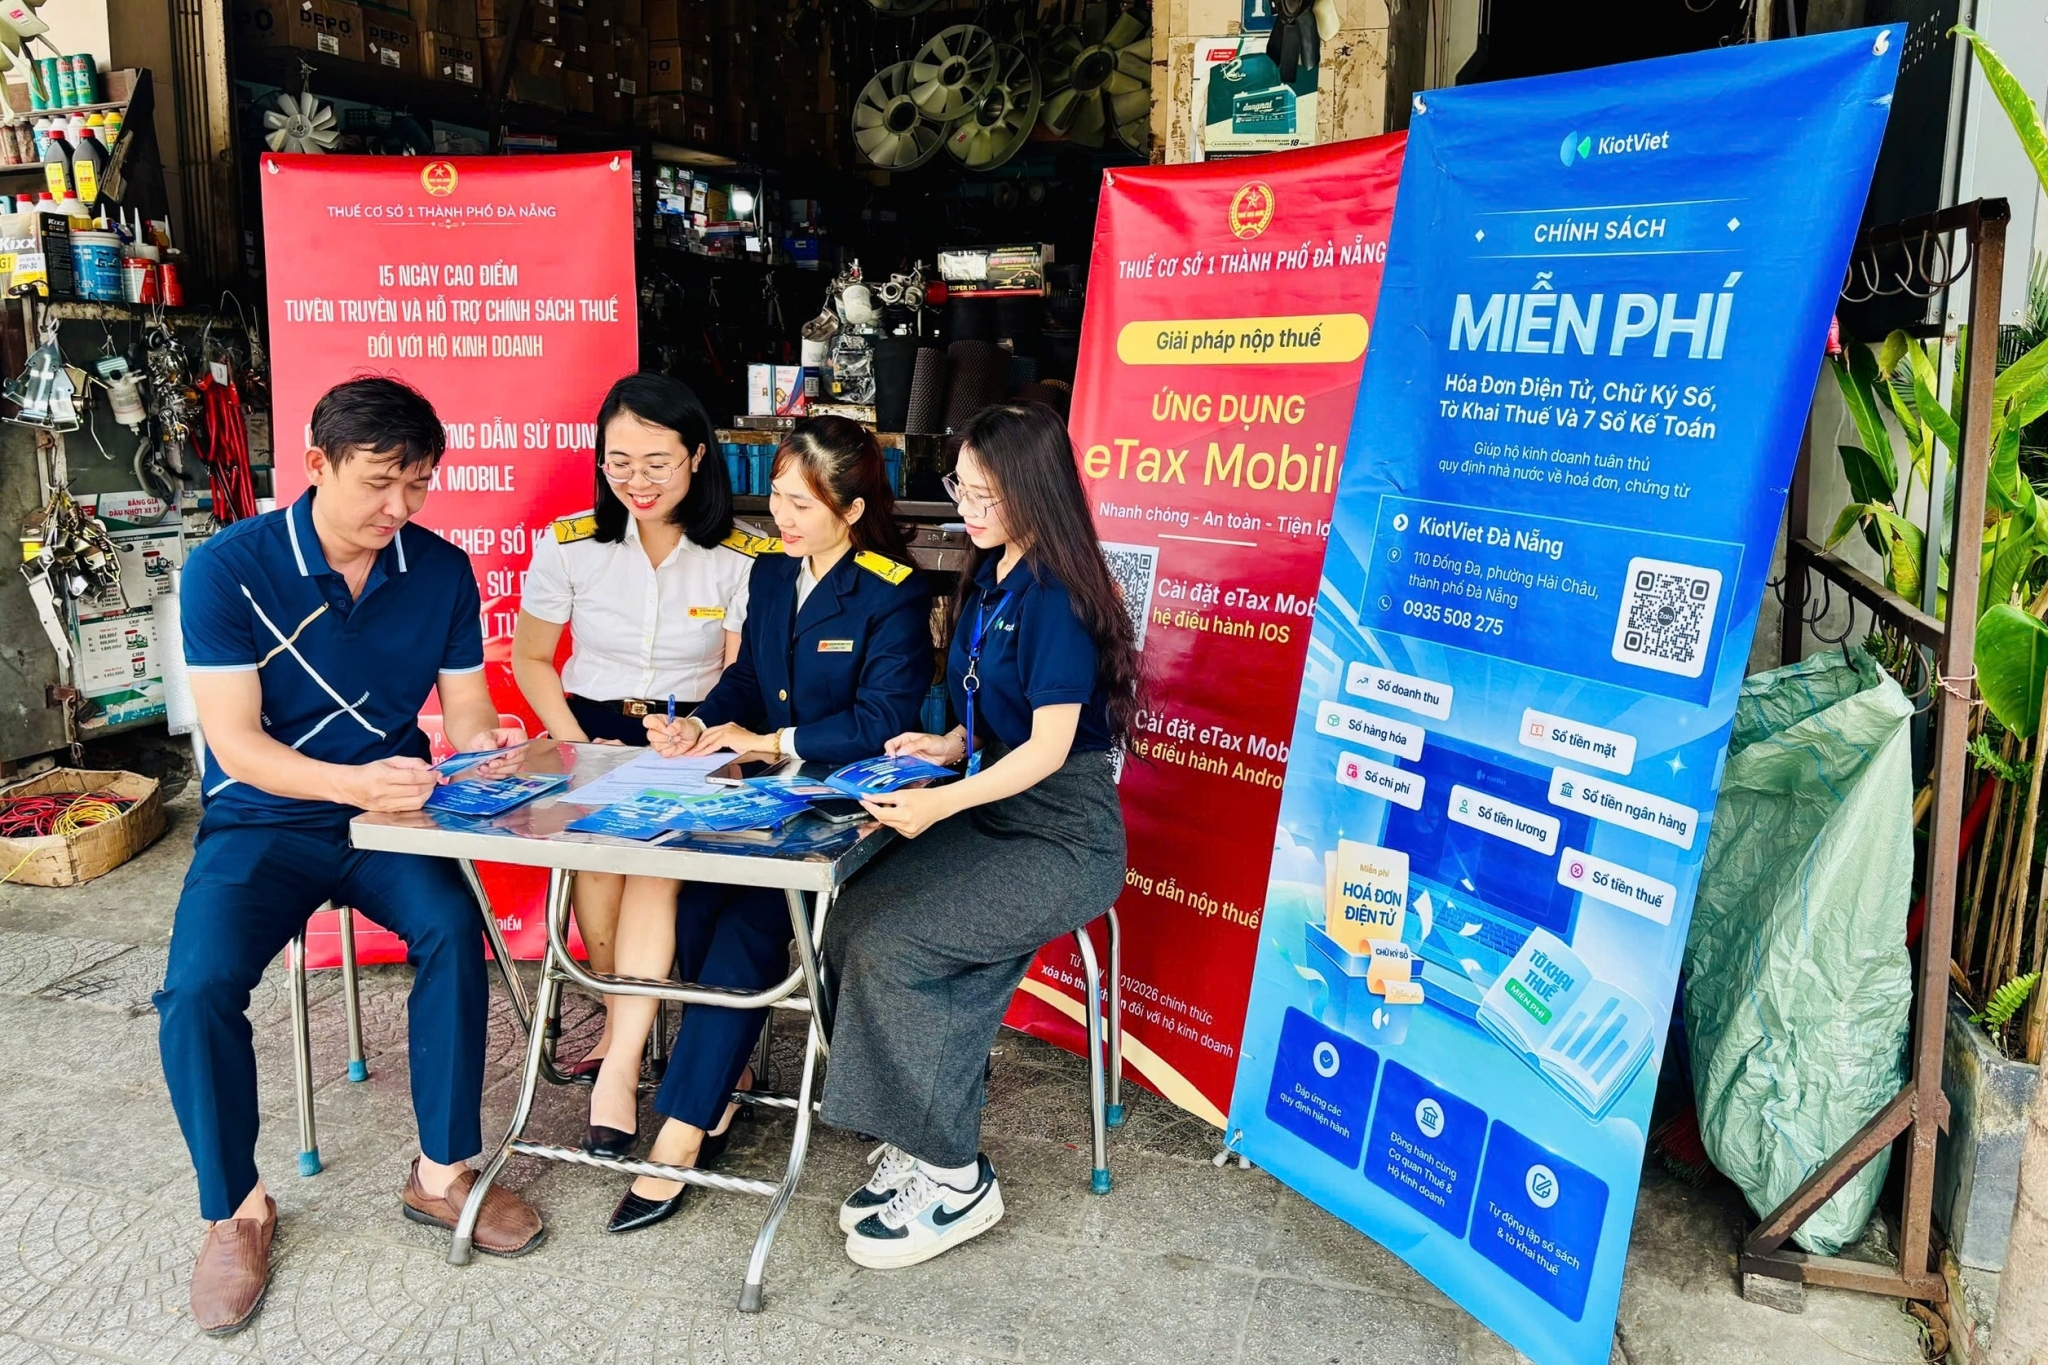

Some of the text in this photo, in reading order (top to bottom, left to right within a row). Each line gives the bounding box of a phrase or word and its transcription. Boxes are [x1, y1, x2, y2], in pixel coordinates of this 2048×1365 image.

[1598, 131, 1669, 155] KiotViet
[327, 202, 556, 218] THUẾ CƠ SỞ 1 THÀNH PHỐ ĐÀ NẴNG
[0, 238, 36, 250] Kixx
[1534, 215, 1666, 243] CHÍNH SÁCH
[379, 259, 518, 286] 15 NGÀY CAO ĐIỂM
[1118, 234, 1386, 279] THUẾ CƠ SỞ 1 THÀNH PHỐ ĐÀ NẴNG
[285, 293, 618, 324] TUYÊN TRUYỀN VÀ HỖ TRỢ CHÍNH SÁCH THUẾ
[1449, 271, 1743, 359] MIỄN PHÍ
[368, 331, 543, 360] ĐỐI VỚI HỘ KINH DOANH
[1156, 323, 1323, 353] Giải pháp nộp thuế
[1152, 386, 1305, 431] ỨNG DỤNG
[1445, 374, 1718, 411] Hóa Đơn Điện Tử, Chữ Ký Số,
[481, 417, 518, 449] DẪN
[524, 419, 552, 449] SỬ
[1439, 401, 1716, 439] Tờ Khai Thuế Và 7 Sổ Kế Toán
[1084, 439, 1344, 494] eTax Mobil
[1474, 442, 1650, 472] Giúp hộ kinh doanh tuân thủ
[448, 465, 514, 491] MOBILE
[1099, 501, 1311, 538] Nhanh chóng An toàn Tiện
[450, 525, 495, 554] CHÉP
[501, 522, 525, 554] SỔ
[1419, 516, 1564, 560] KiotViet Đà Nẵng
[487, 566, 514, 596] SỬ
[1414, 551, 1599, 600] 110 Đống Đa, phường Hải Châu,
[1158, 578, 1268, 611] Cài đặt eTax
[1153, 608, 1289, 644] hệ điều hành IOS
[1403, 600, 1504, 636] 0935 508 275
[1658, 611, 1674, 621] Zalo
[1392, 685, 1421, 700] doanh
[1423, 691, 1439, 705] thu
[1569, 734, 1591, 750] tiền
[1593, 743, 1617, 758] mặt
[1600, 795, 1624, 812] tiền
[1625, 804, 1656, 822] ngân
[1658, 811, 1687, 835] hàng
[1156, 878, 1261, 929] dẫn nộp thuế
[1343, 882, 1402, 907] HOÁ ĐƠN
[1611, 878, 1633, 896] tiền
[1636, 886, 1664, 908] thuế
[1345, 904, 1396, 926] ĐIỆN TỬ
[1524, 969, 1559, 1002] THUẾ
[1529, 949, 1574, 992] TỜ KHAI
[1295, 1083, 1342, 1116] Đáp ứng các
[1280, 1093, 1350, 1139] quy định hiện hành
[1489, 1201, 1501, 1217] Tự
[1502, 1213, 1525, 1235] động
[1526, 1228, 1540, 1244] lập
[1556, 1249, 1580, 1270] sách
